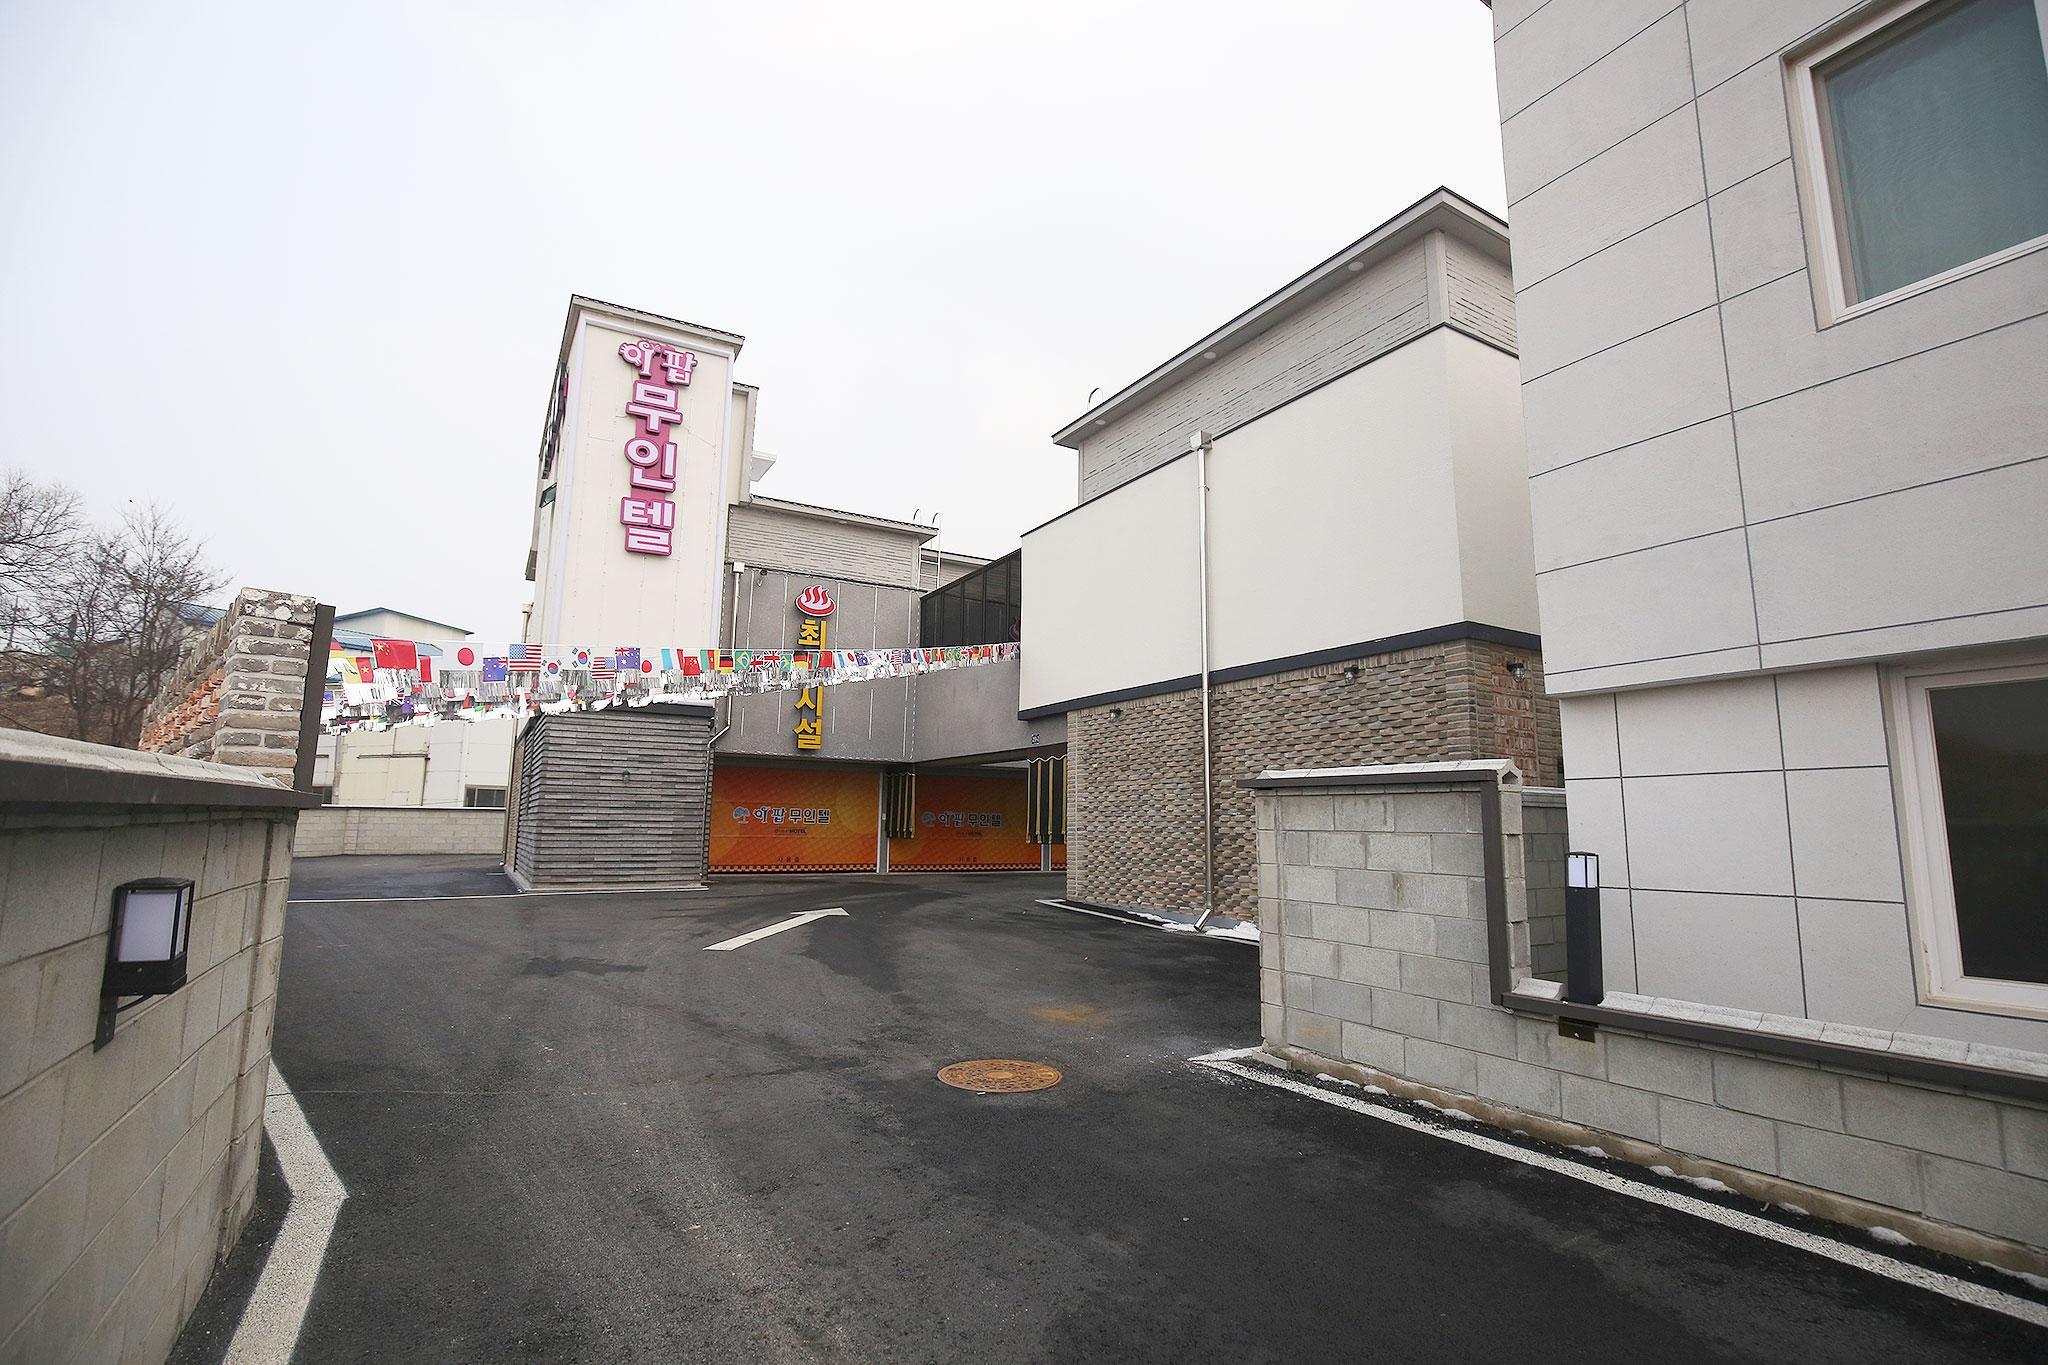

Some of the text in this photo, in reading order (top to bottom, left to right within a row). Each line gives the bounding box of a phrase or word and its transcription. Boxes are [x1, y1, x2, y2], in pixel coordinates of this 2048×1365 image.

[620, 379, 683, 556] 무인텔
[793, 619, 828, 750] 최시설
[788, 808, 831, 824] 무인텔
[967, 813, 1001, 828] 무인텔
